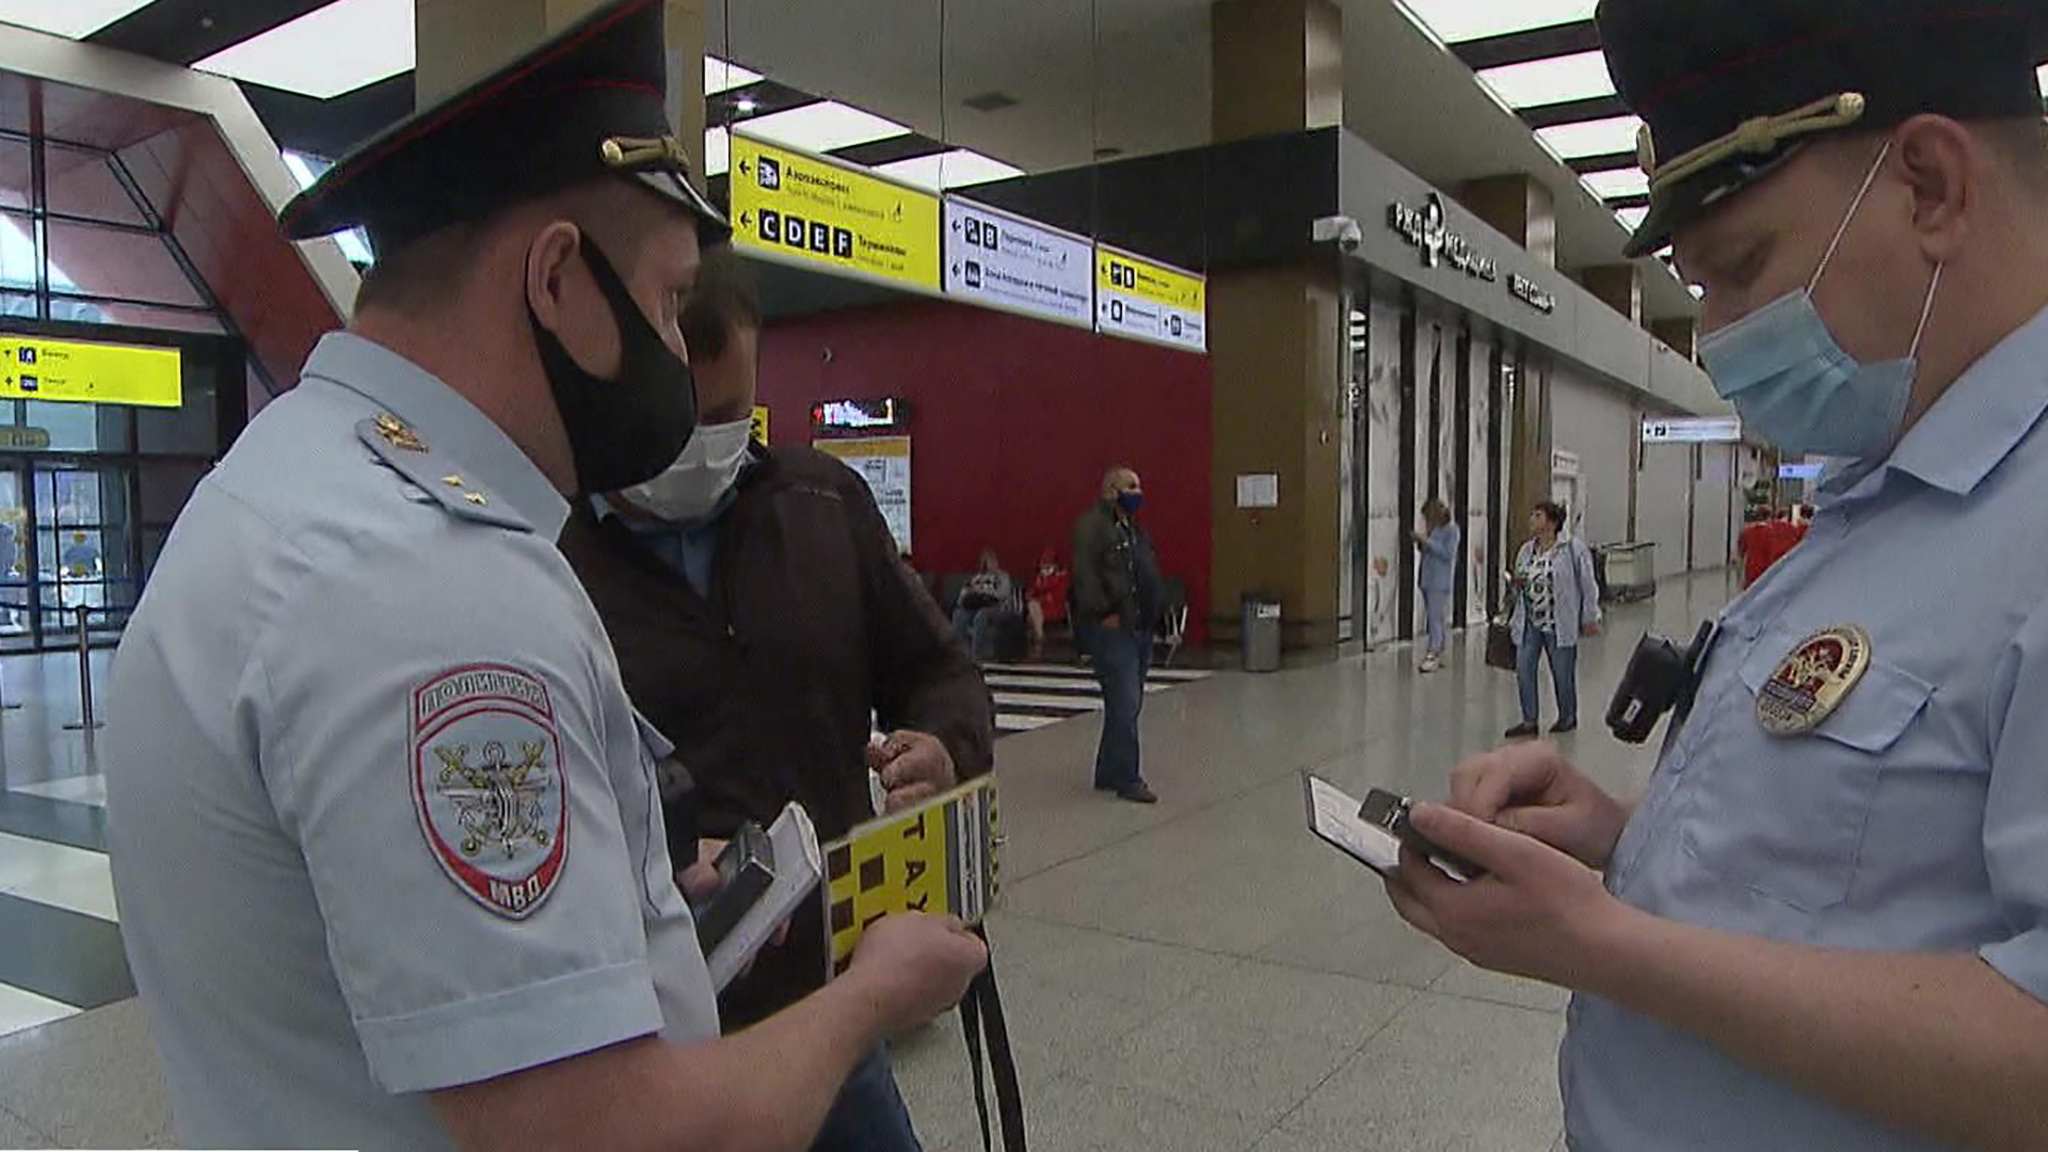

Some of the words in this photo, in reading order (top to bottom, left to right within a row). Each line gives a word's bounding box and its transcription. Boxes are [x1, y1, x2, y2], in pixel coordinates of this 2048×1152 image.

[764, 216, 776, 237] C
[788, 223, 802, 247] D
[814, 229, 825, 250] E
[838, 231, 849, 254] F
[420, 671, 547, 716] ПОЛИЦИЯ
[488, 875, 542, 909] МВД
